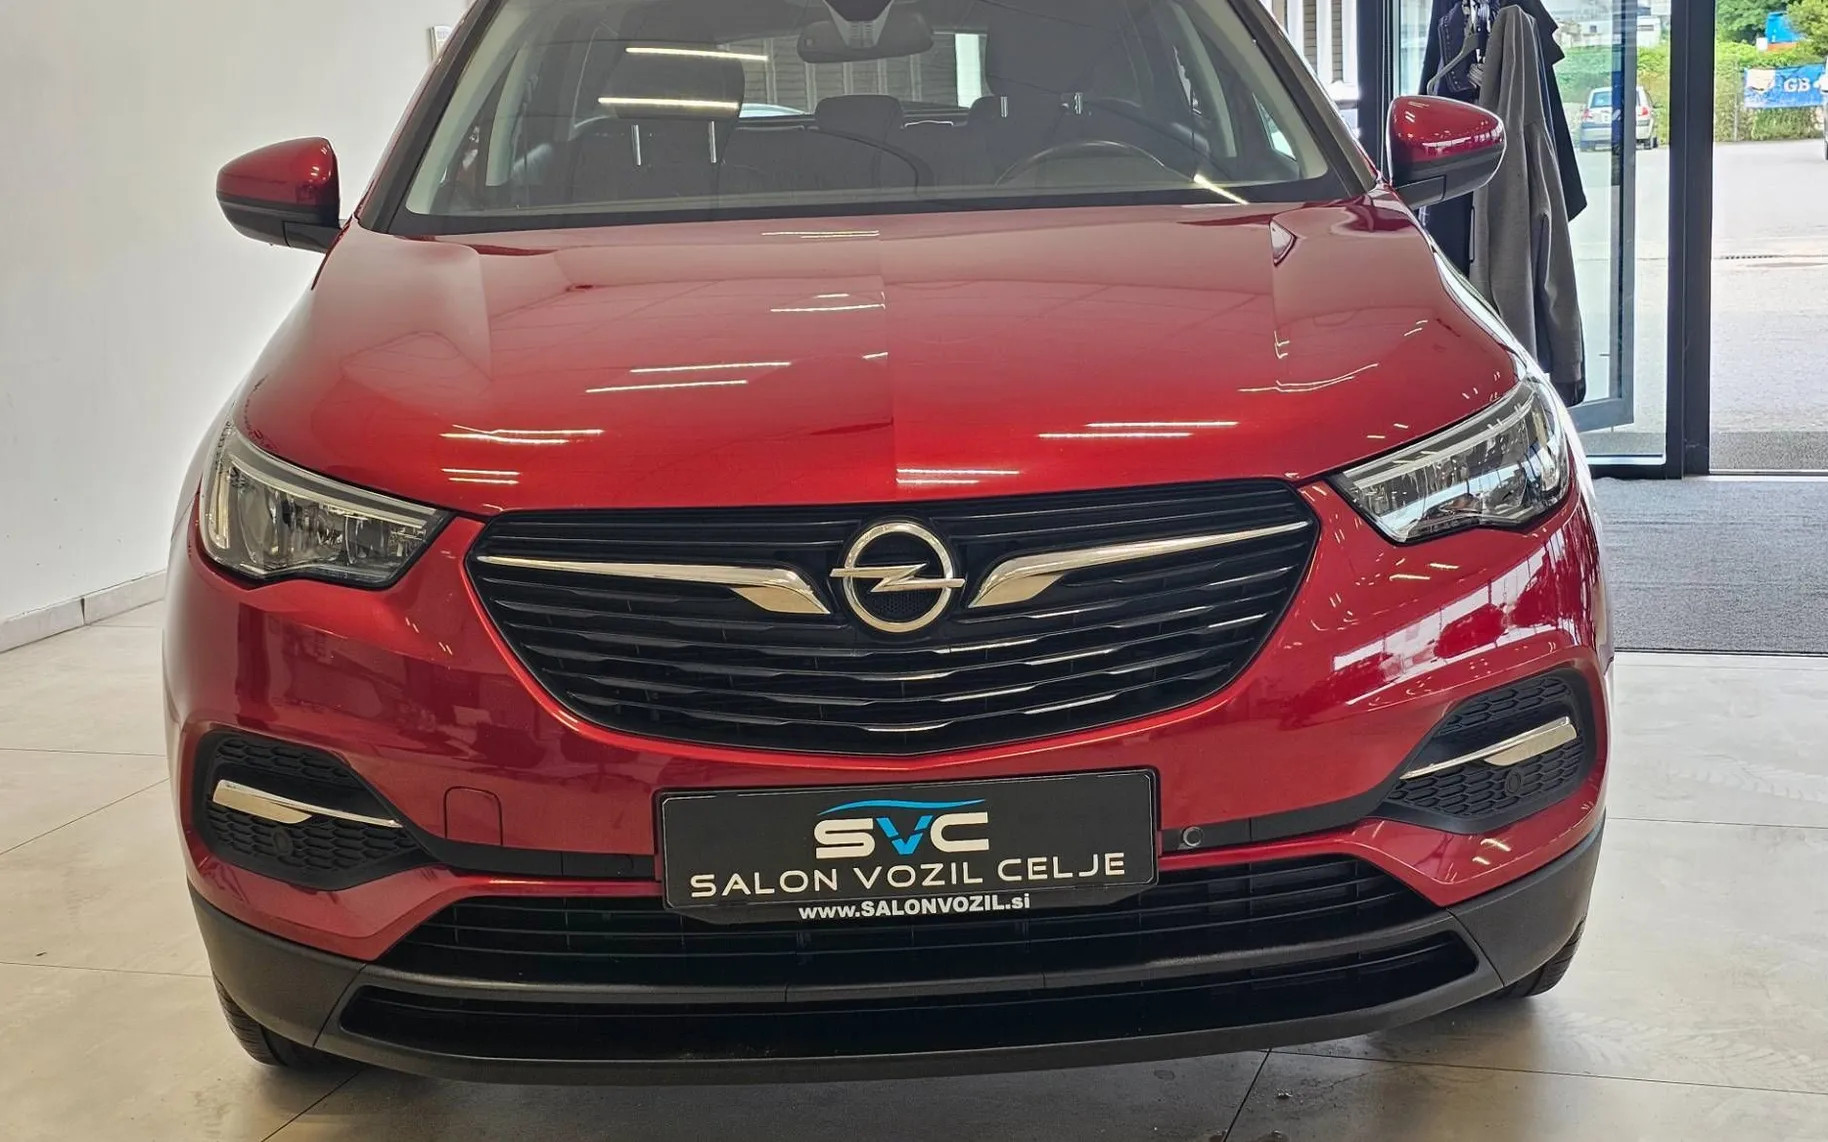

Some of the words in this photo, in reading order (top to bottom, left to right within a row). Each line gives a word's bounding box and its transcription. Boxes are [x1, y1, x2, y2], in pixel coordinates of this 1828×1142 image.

[1783, 77, 1811, 92] GB
[815, 812, 989, 858] SVC
[691, 869, 838, 898] SALON
[854, 861, 983, 890] VOZIL
[997, 853, 1126, 882] CELJE
[798, 894, 1030, 919] www.SALONVOZIL.si
